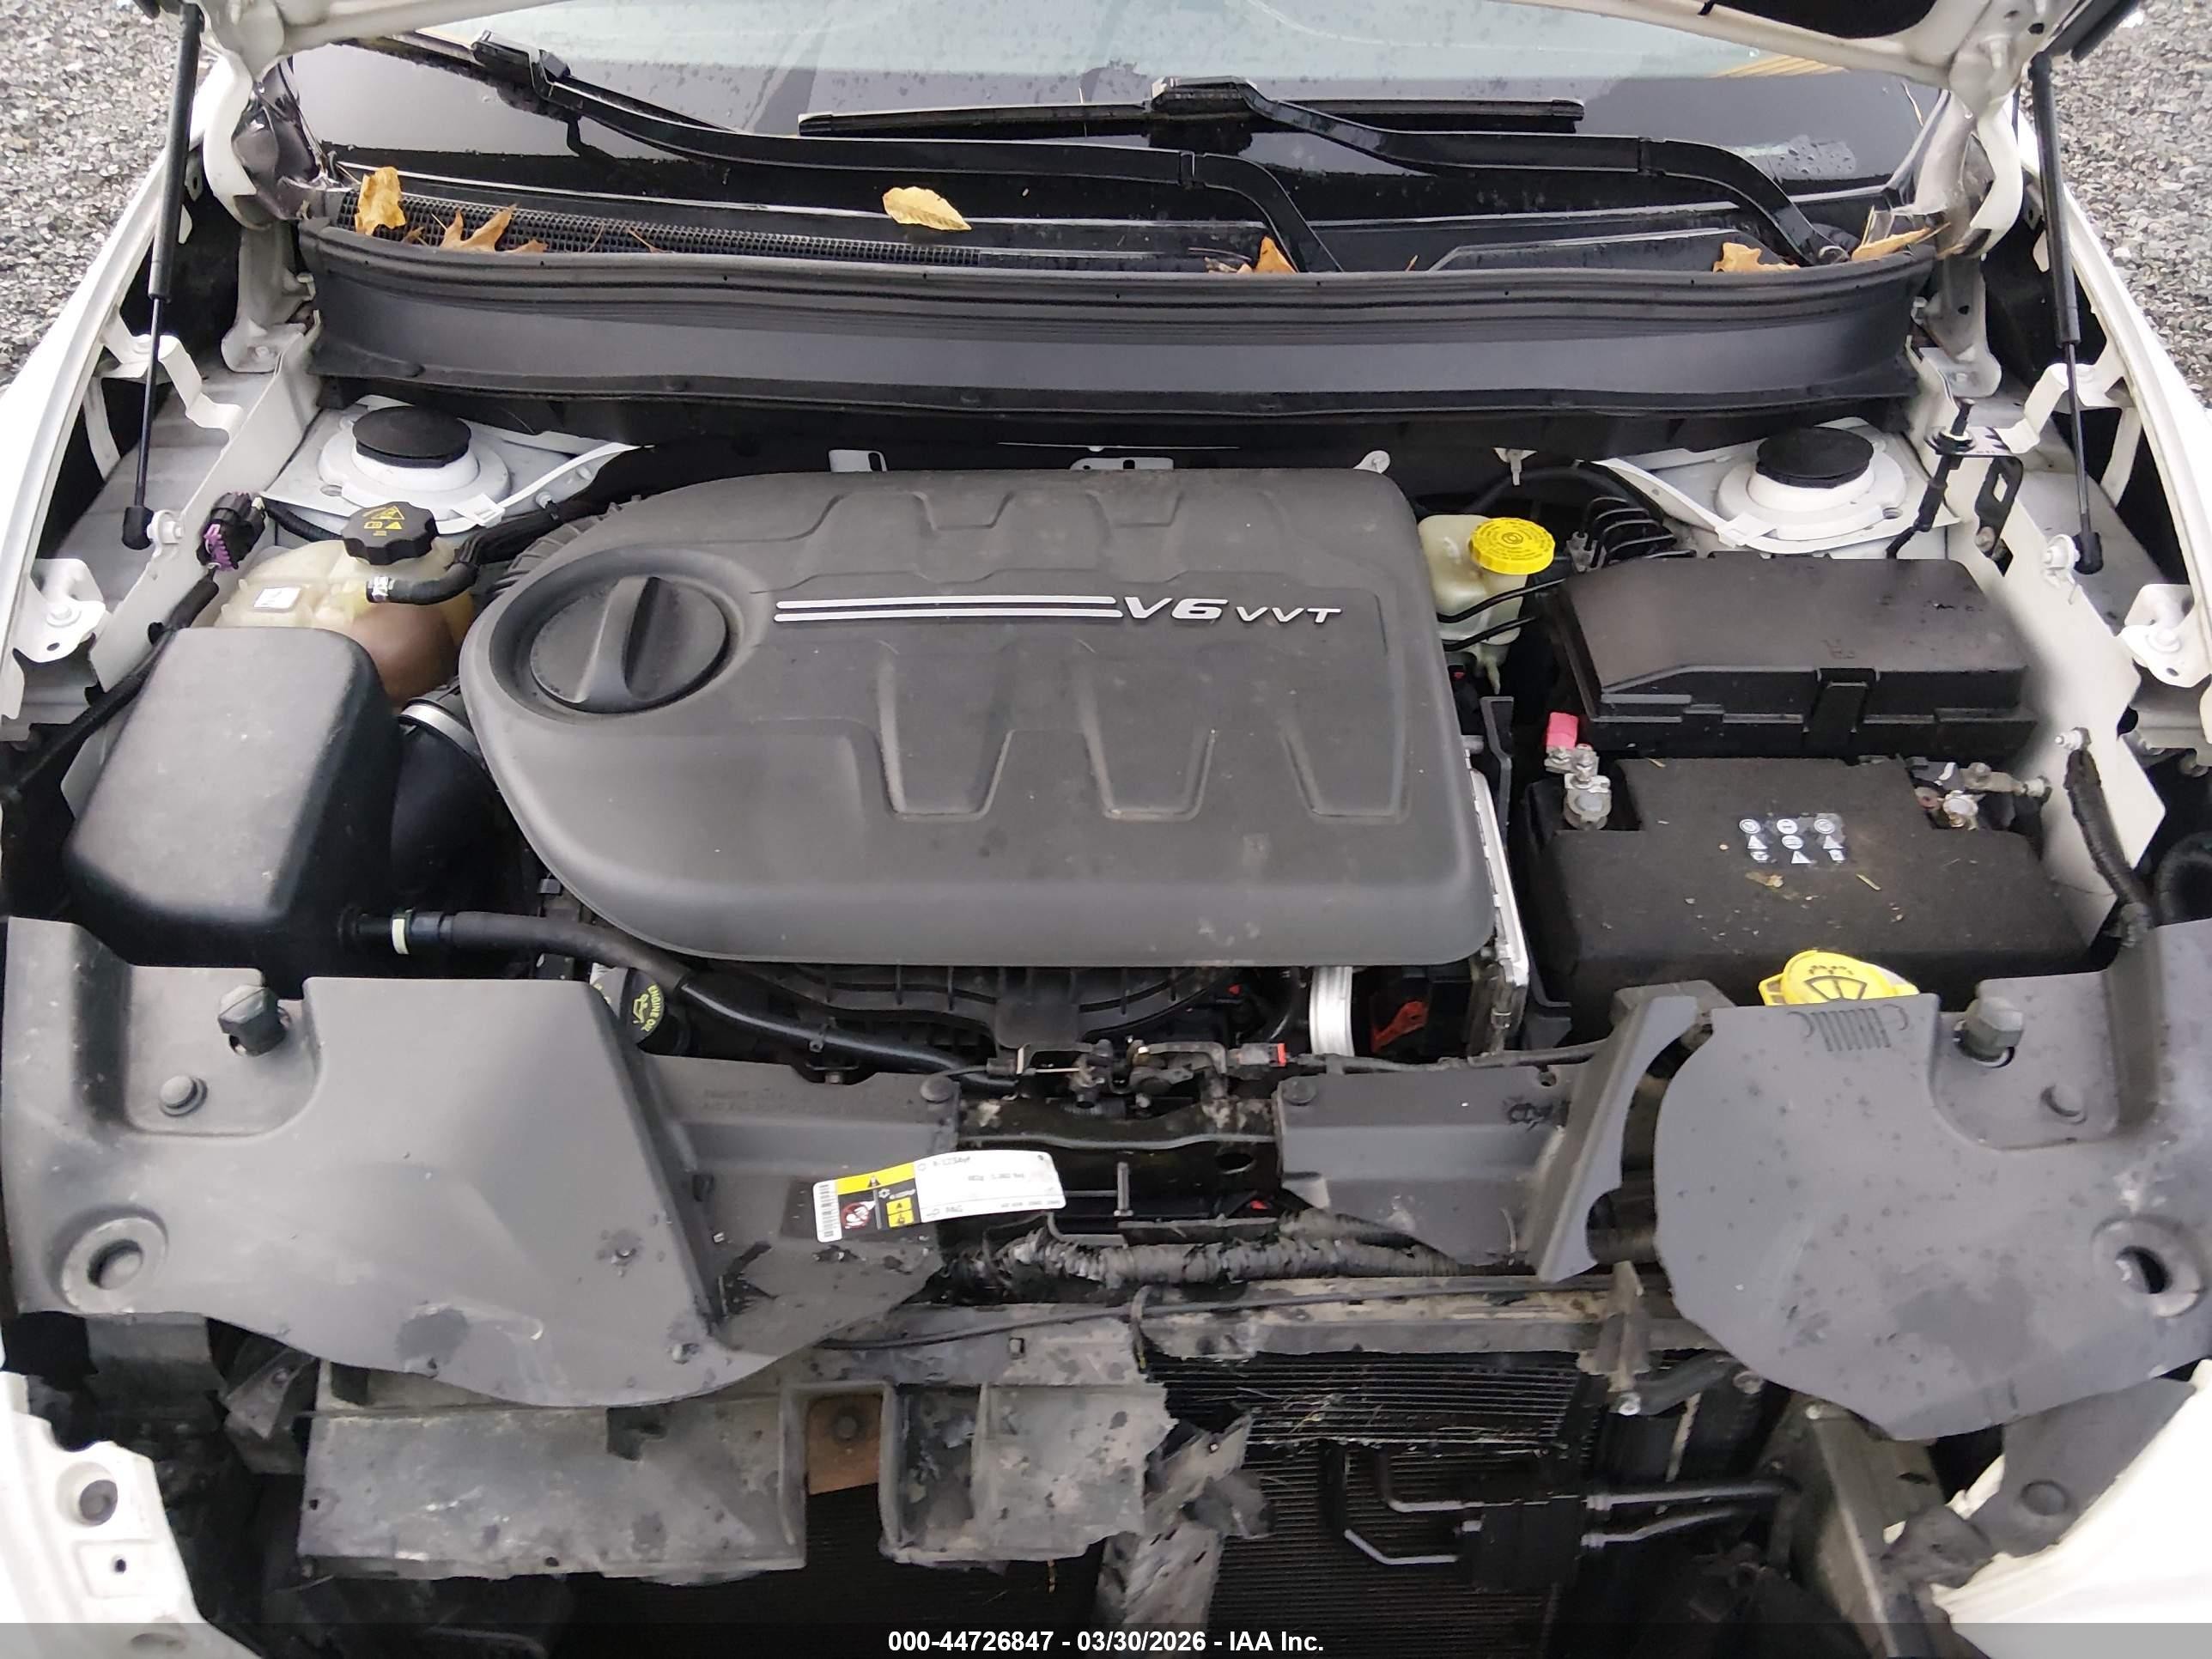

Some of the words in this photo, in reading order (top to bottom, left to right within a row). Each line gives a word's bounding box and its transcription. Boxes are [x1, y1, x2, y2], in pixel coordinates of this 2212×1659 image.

[1123, 596, 1229, 620] V6
[1236, 606, 1342, 623] VVT
[647, 984, 661, 1018] ENGINE
